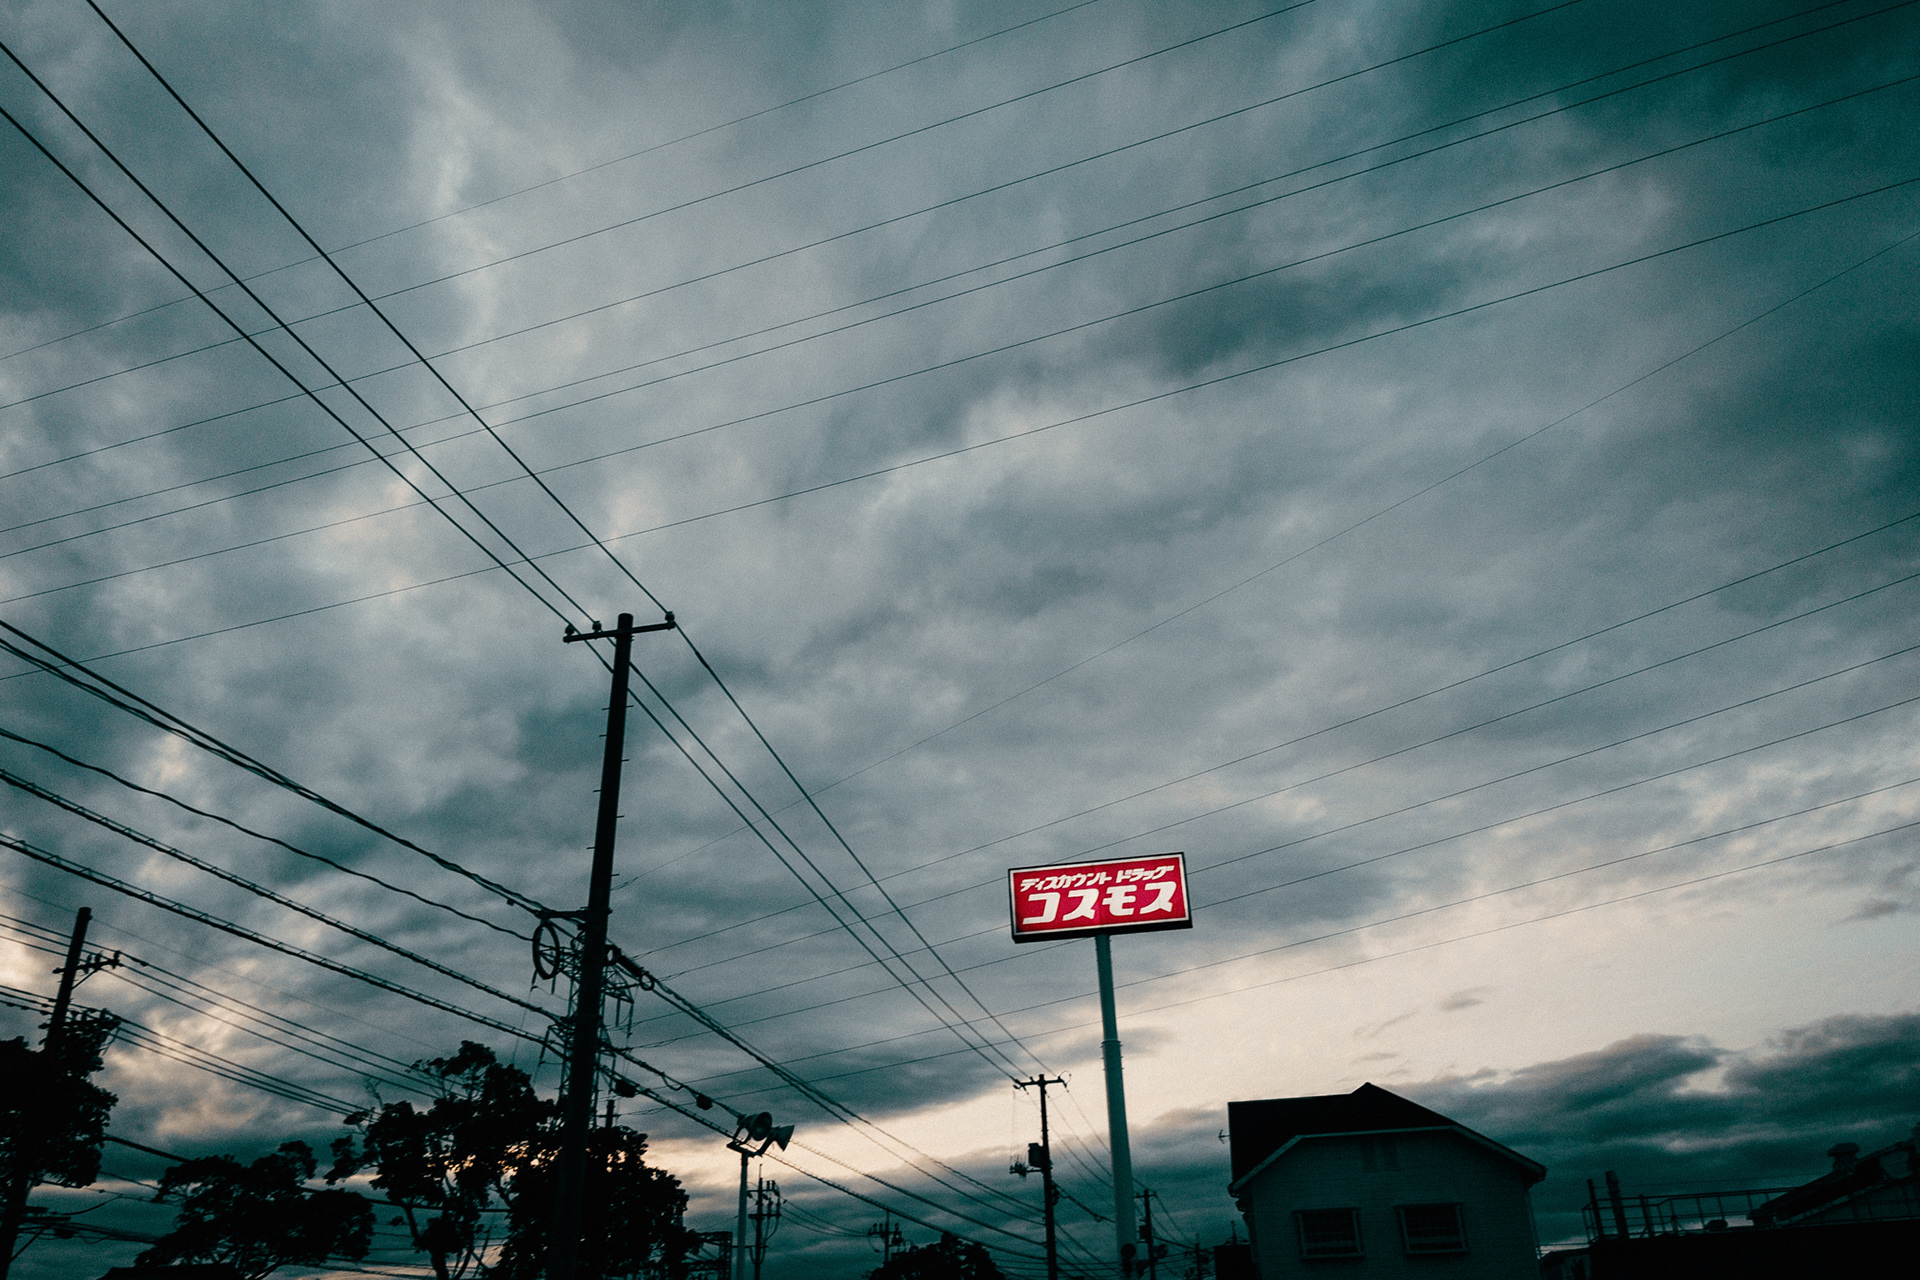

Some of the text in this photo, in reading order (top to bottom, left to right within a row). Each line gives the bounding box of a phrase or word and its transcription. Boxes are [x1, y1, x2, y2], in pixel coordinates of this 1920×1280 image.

[1020, 865, 1175, 892] ディスカウント ドラッグ
[1022, 881, 1177, 925] コスモス
